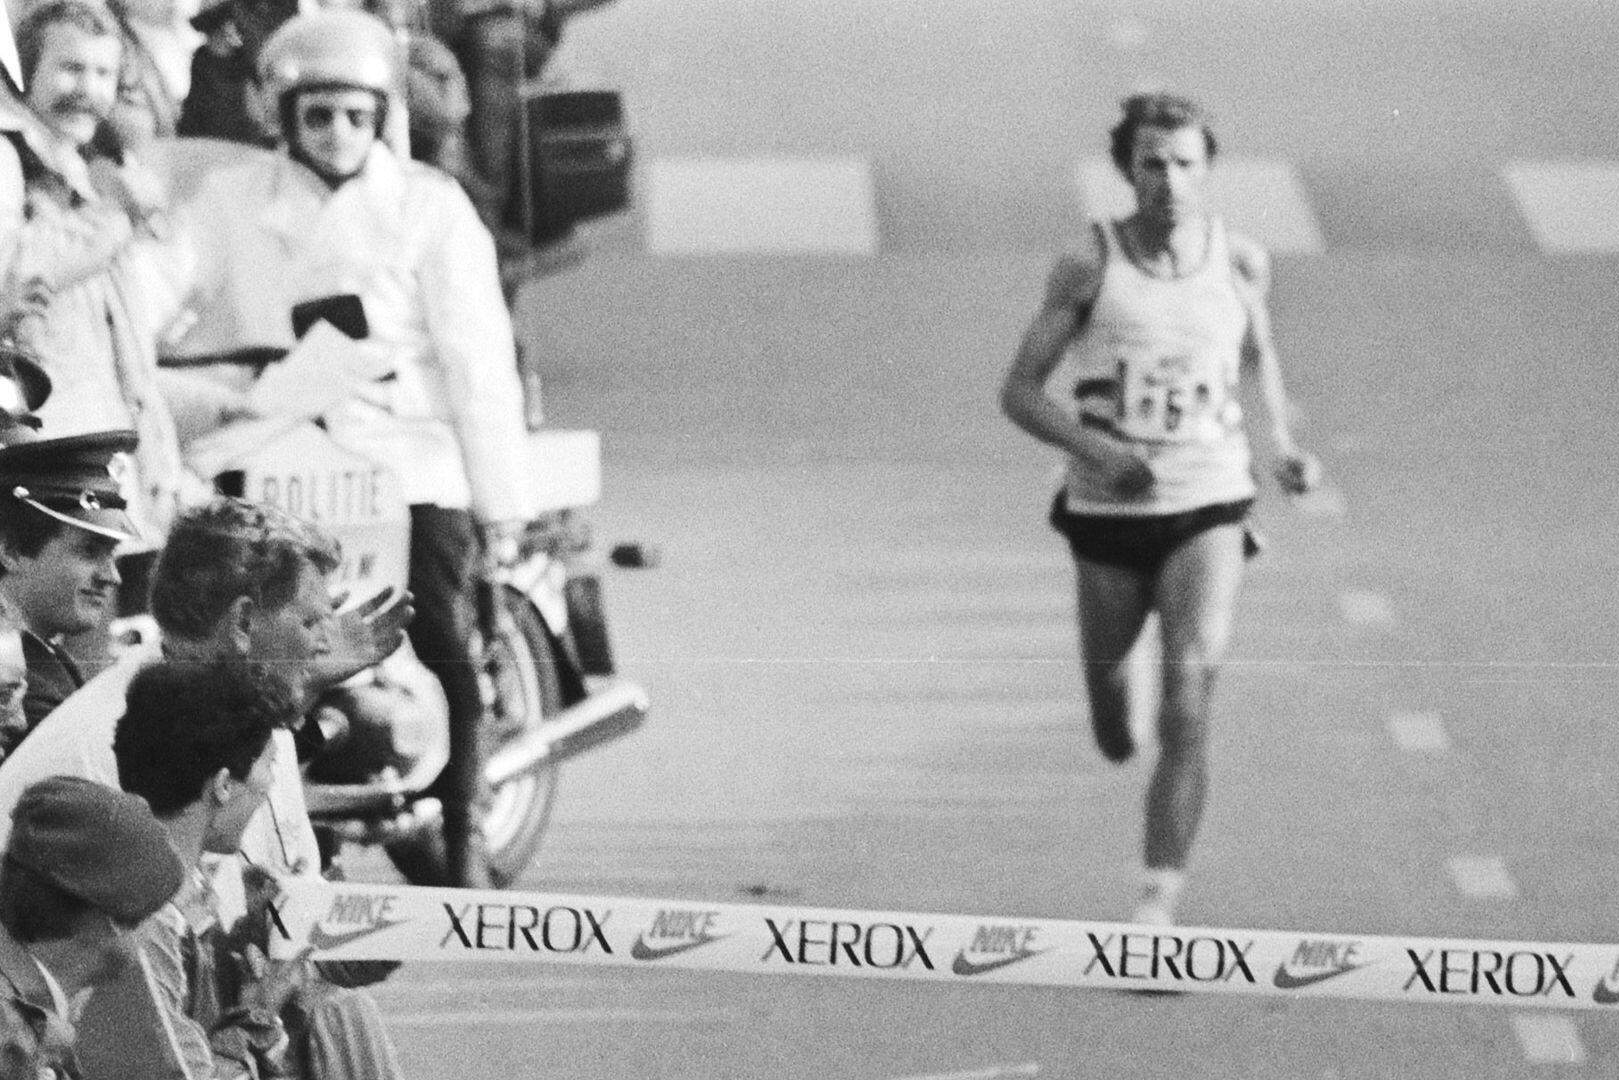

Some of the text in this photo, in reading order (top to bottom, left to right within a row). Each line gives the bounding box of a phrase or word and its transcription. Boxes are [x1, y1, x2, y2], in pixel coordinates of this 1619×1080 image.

[262, 471, 381, 519] POLITIE
[329, 893, 397, 929] NIKE
[441, 902, 613, 954] XEROX
[650, 910, 721, 942] NIKE
[761, 917, 934, 970] XEROX
[971, 925, 1040, 956] NIKE
[1082, 931, 1256, 983] XEROX
[1292, 939, 1363, 970] NIKE
[1402, 947, 1577, 998] XEROX
